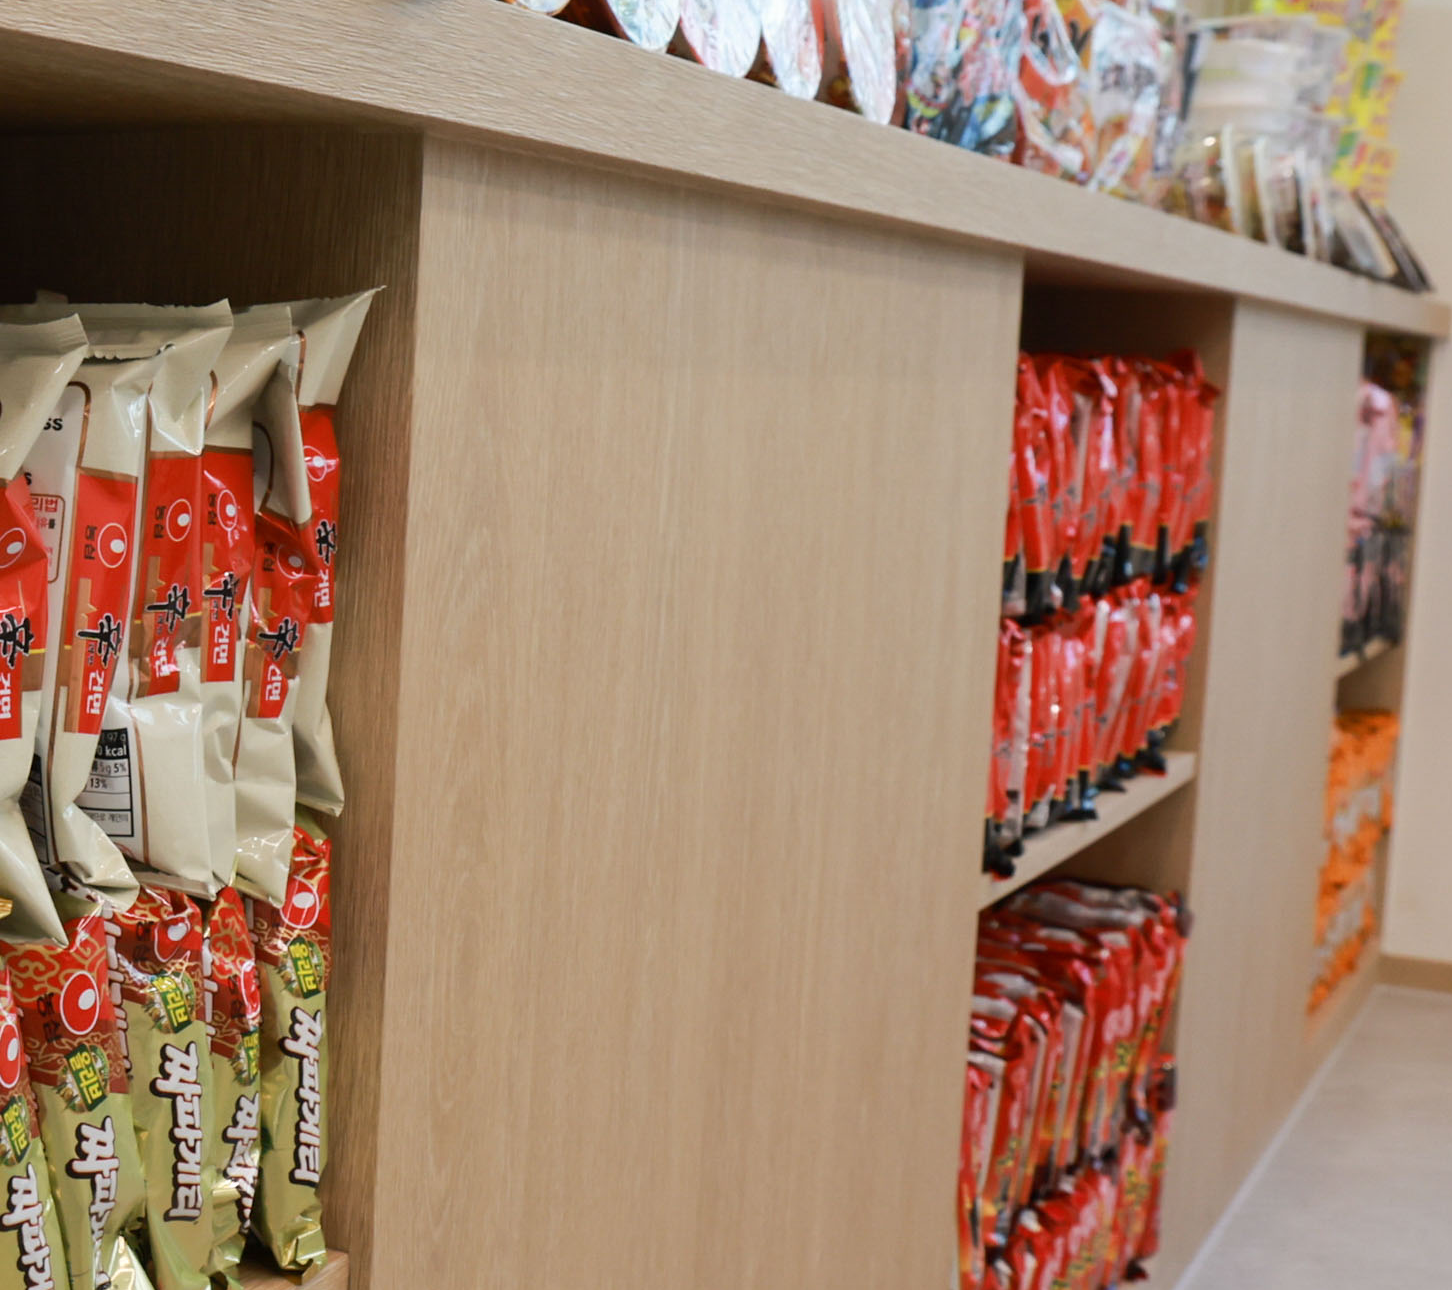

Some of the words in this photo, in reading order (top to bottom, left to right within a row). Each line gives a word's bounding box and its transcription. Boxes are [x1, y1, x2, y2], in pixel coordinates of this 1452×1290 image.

[148, 582, 191, 632] 辛
[78, 612, 123, 668] 辛
[212, 623, 230, 666] 건면
[258, 615, 299, 661] 辛
[86, 669, 105, 716] 건면
[264, 662, 283, 704] 건면
[105, 744, 127, 756] kcal
[72, 1047, 103, 1103] 올리브
[280, 1009, 322, 1185] 짜파게티
[4, 1103, 30, 1154] 올리브
[151, 1043, 203, 1222] 짜파게티
